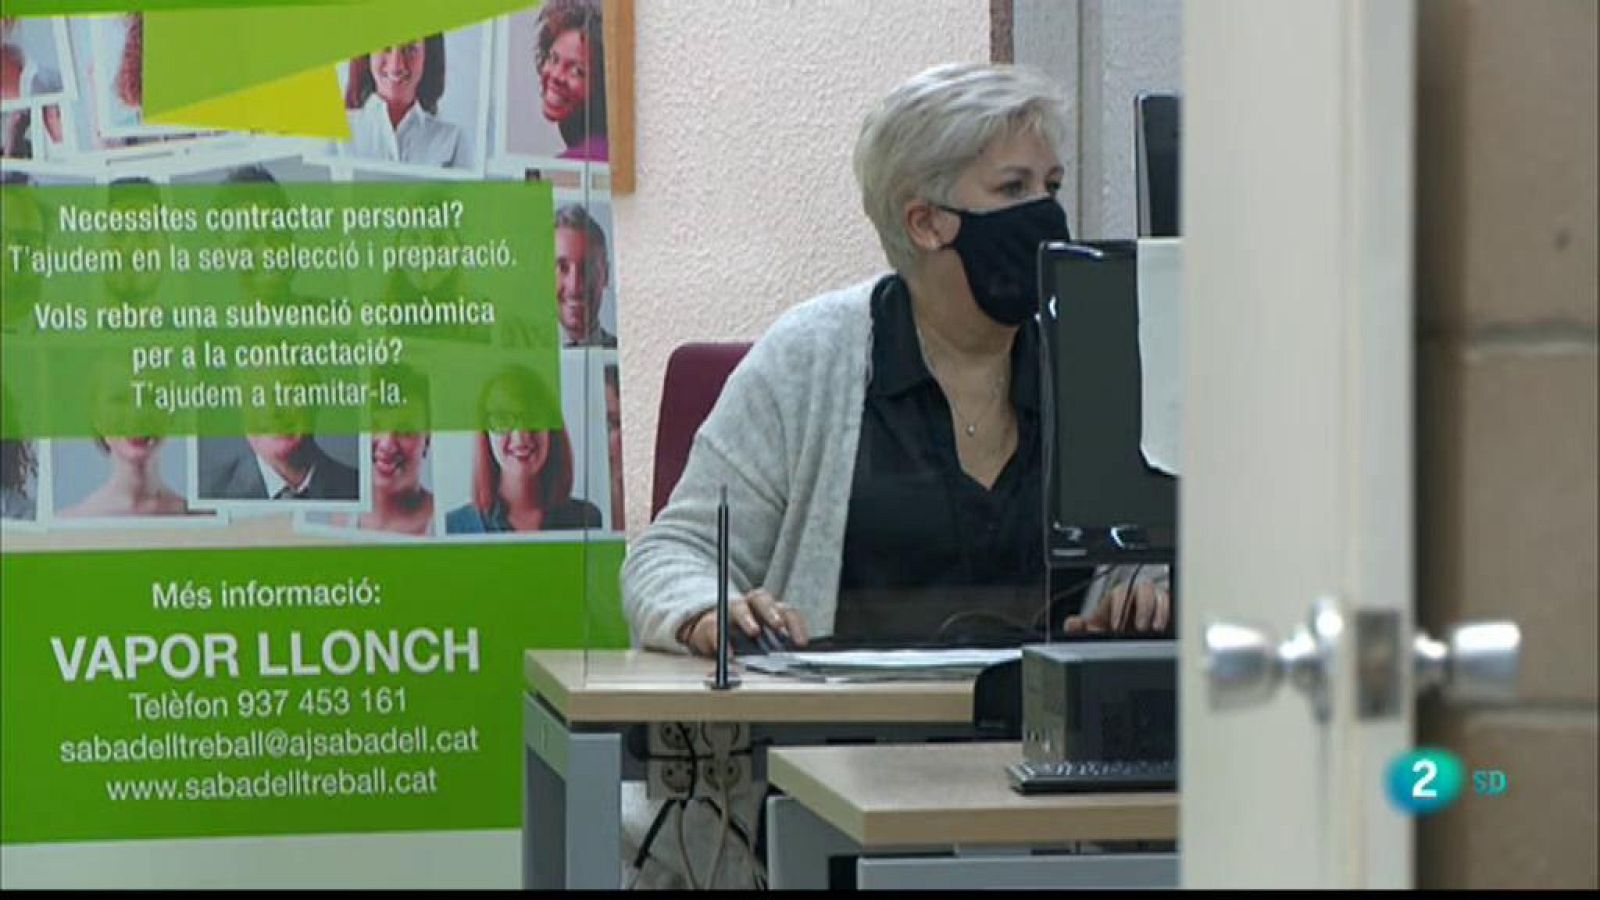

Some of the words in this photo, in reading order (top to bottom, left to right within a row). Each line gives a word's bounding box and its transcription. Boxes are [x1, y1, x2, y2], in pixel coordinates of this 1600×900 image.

[60, 204, 197, 232] Necessites
[206, 205, 332, 231] contractar
[343, 200, 464, 235] personal?
[8, 246, 123, 276] T'ajudem
[132, 249, 161, 272] en
[170, 245, 191, 271] la
[199, 248, 254, 270] seva
[262, 244, 360, 269] selecció
[368, 245, 374, 268] i
[382, 242, 517, 273] preparació.
[35, 304, 87, 330] Vols
[97, 303, 164, 329] rebre
[172, 306, 217, 328] una
[226, 299, 352, 327] subvenció
[360, 299, 495, 325] econòmica
[133, 346, 172, 373] per
[181, 345, 195, 367] a
[204, 340, 226, 366] la
[235, 338, 404, 366] contractació?
[132, 381, 243, 413] T'ajudem
[252, 385, 266, 407] a
[274, 380, 407, 406] tramitar-la.
[151, 582, 212, 609] Més
[221, 579, 381, 608] informació:
[50, 633, 240, 682] VAPOR
[257, 627, 480, 677] LLONCH
[129, 693, 229, 721] Telèfon
[238, 690, 288, 718] 937
[299, 689, 350, 716] 453
[361, 688, 407, 713] 161
[60, 727, 479, 763] sabadelltreball@ajsabadell.cat
[106, 768, 437, 801] www.sabadelltreball.cat
